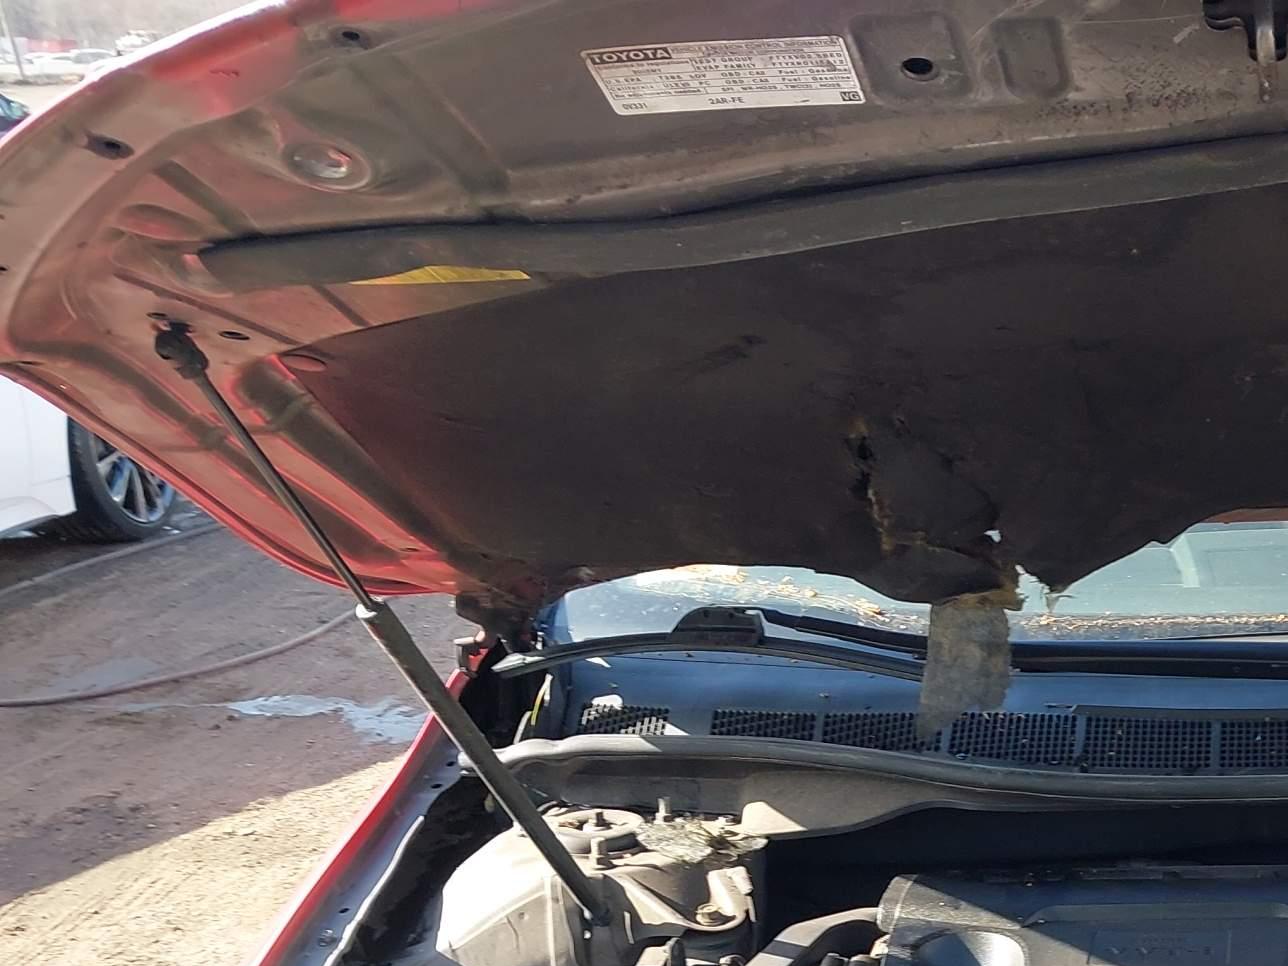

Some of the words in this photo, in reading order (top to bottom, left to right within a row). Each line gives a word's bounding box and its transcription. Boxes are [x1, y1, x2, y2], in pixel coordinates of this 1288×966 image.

[591, 50, 670, 64] TOYOTA
[707, 96, 746, 105] 2AR-FE
[841, 92, 861, 101] VG
